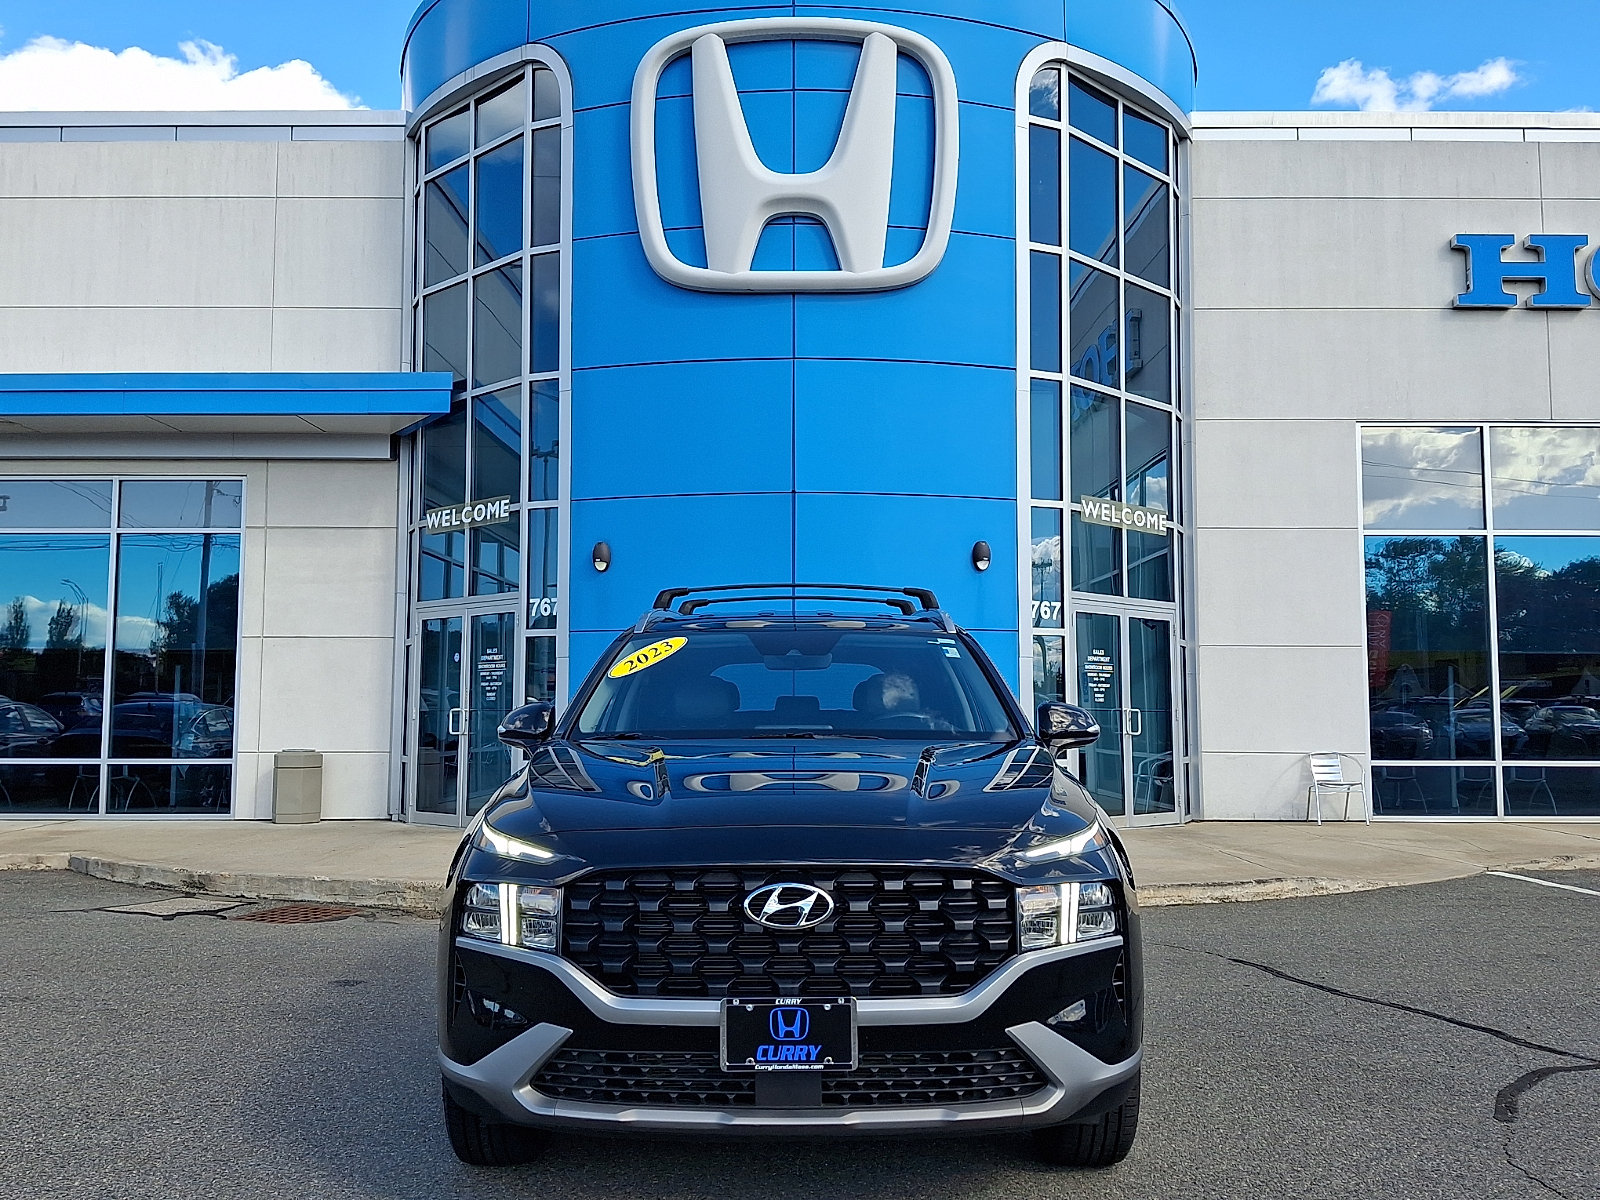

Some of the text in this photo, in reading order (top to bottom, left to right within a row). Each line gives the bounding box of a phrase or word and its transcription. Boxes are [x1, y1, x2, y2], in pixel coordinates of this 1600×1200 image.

[426, 498, 511, 530] WELCOME
[1080, 499, 1168, 532] WELCOME
[530, 597, 557, 617] 767
[1032, 600, 1061, 620] 767
[623, 640, 674, 673] 2023
[756, 1045, 822, 1061] CURRY
